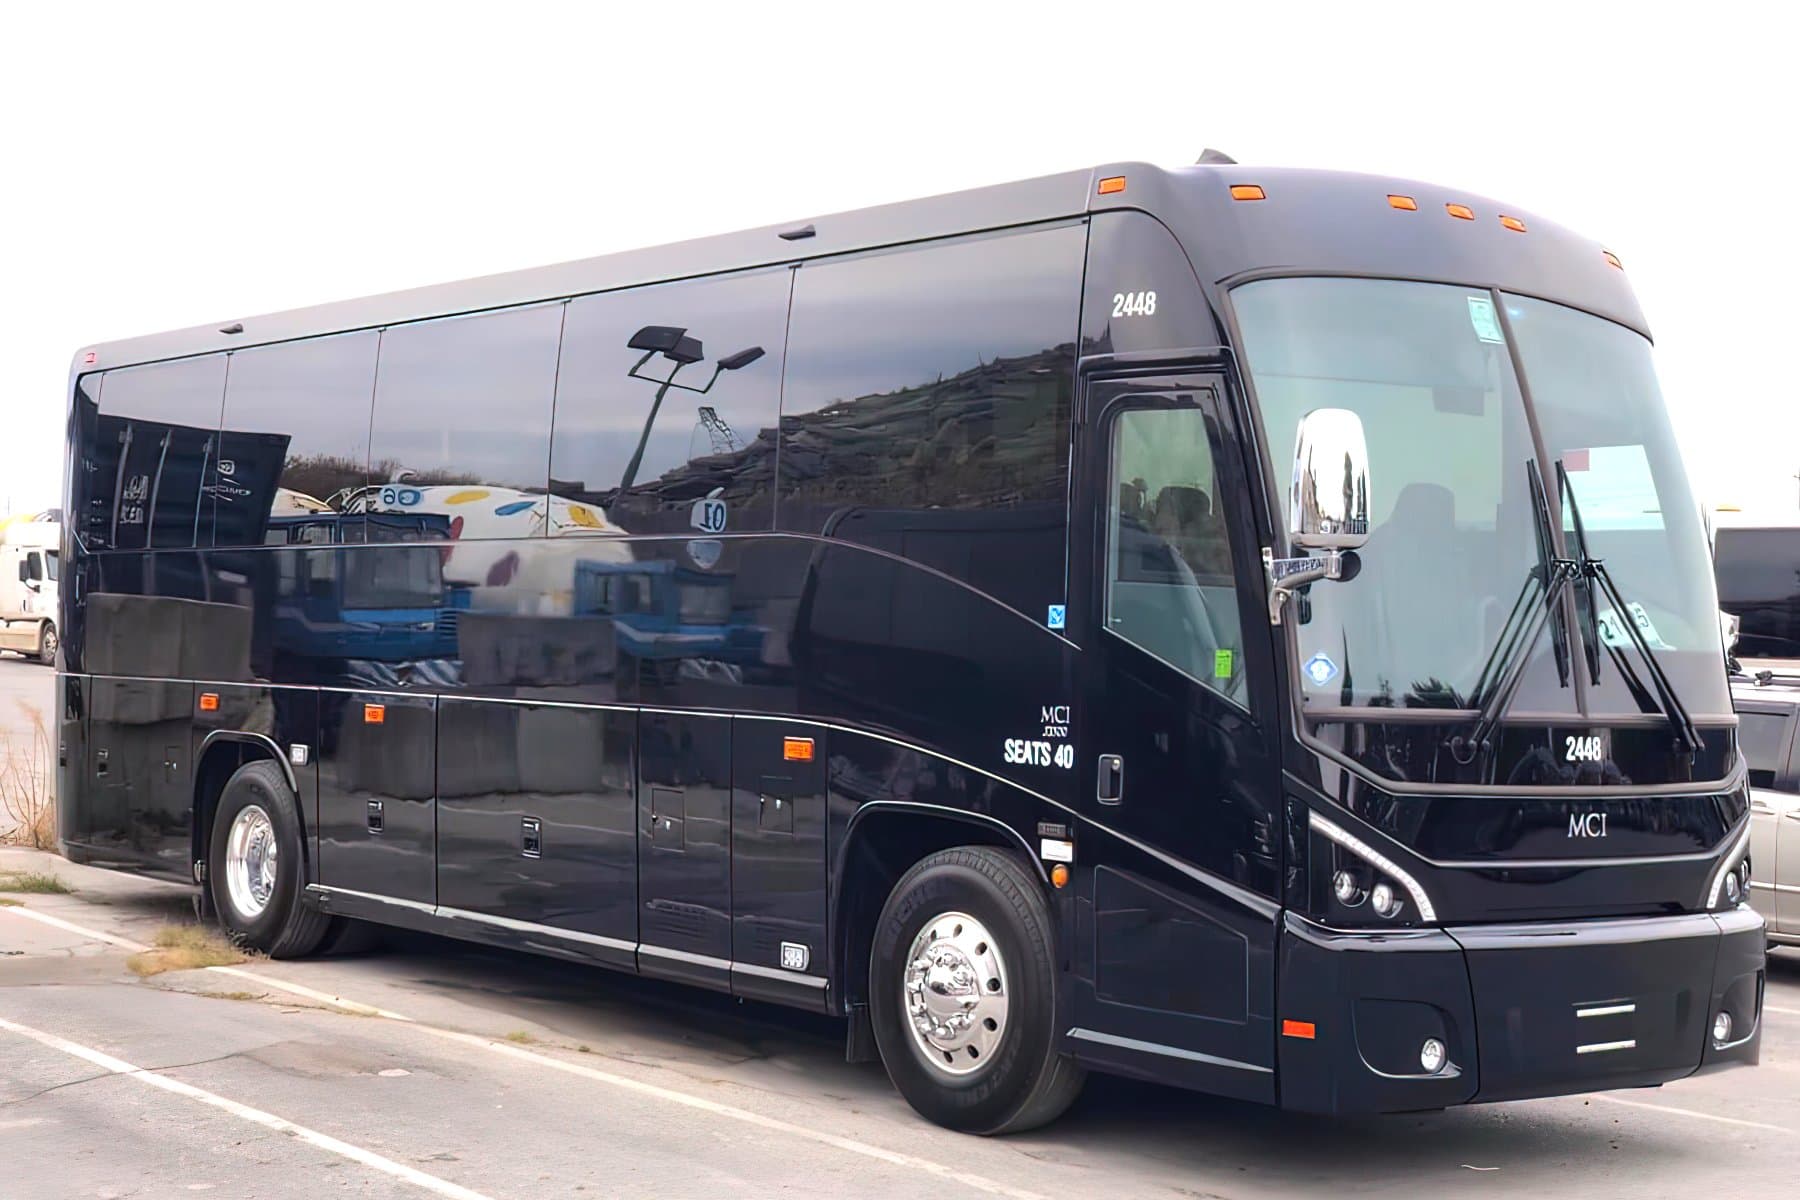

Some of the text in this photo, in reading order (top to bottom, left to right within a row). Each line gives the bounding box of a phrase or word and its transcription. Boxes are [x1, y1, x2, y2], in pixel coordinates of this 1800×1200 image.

[1112, 291, 1156, 317] 2448
[1041, 706, 1070, 723] MCI
[1004, 739, 1073, 768] SEATS 40
[1566, 736, 1601, 760] 2448
[1568, 813, 1607, 837] MCI
